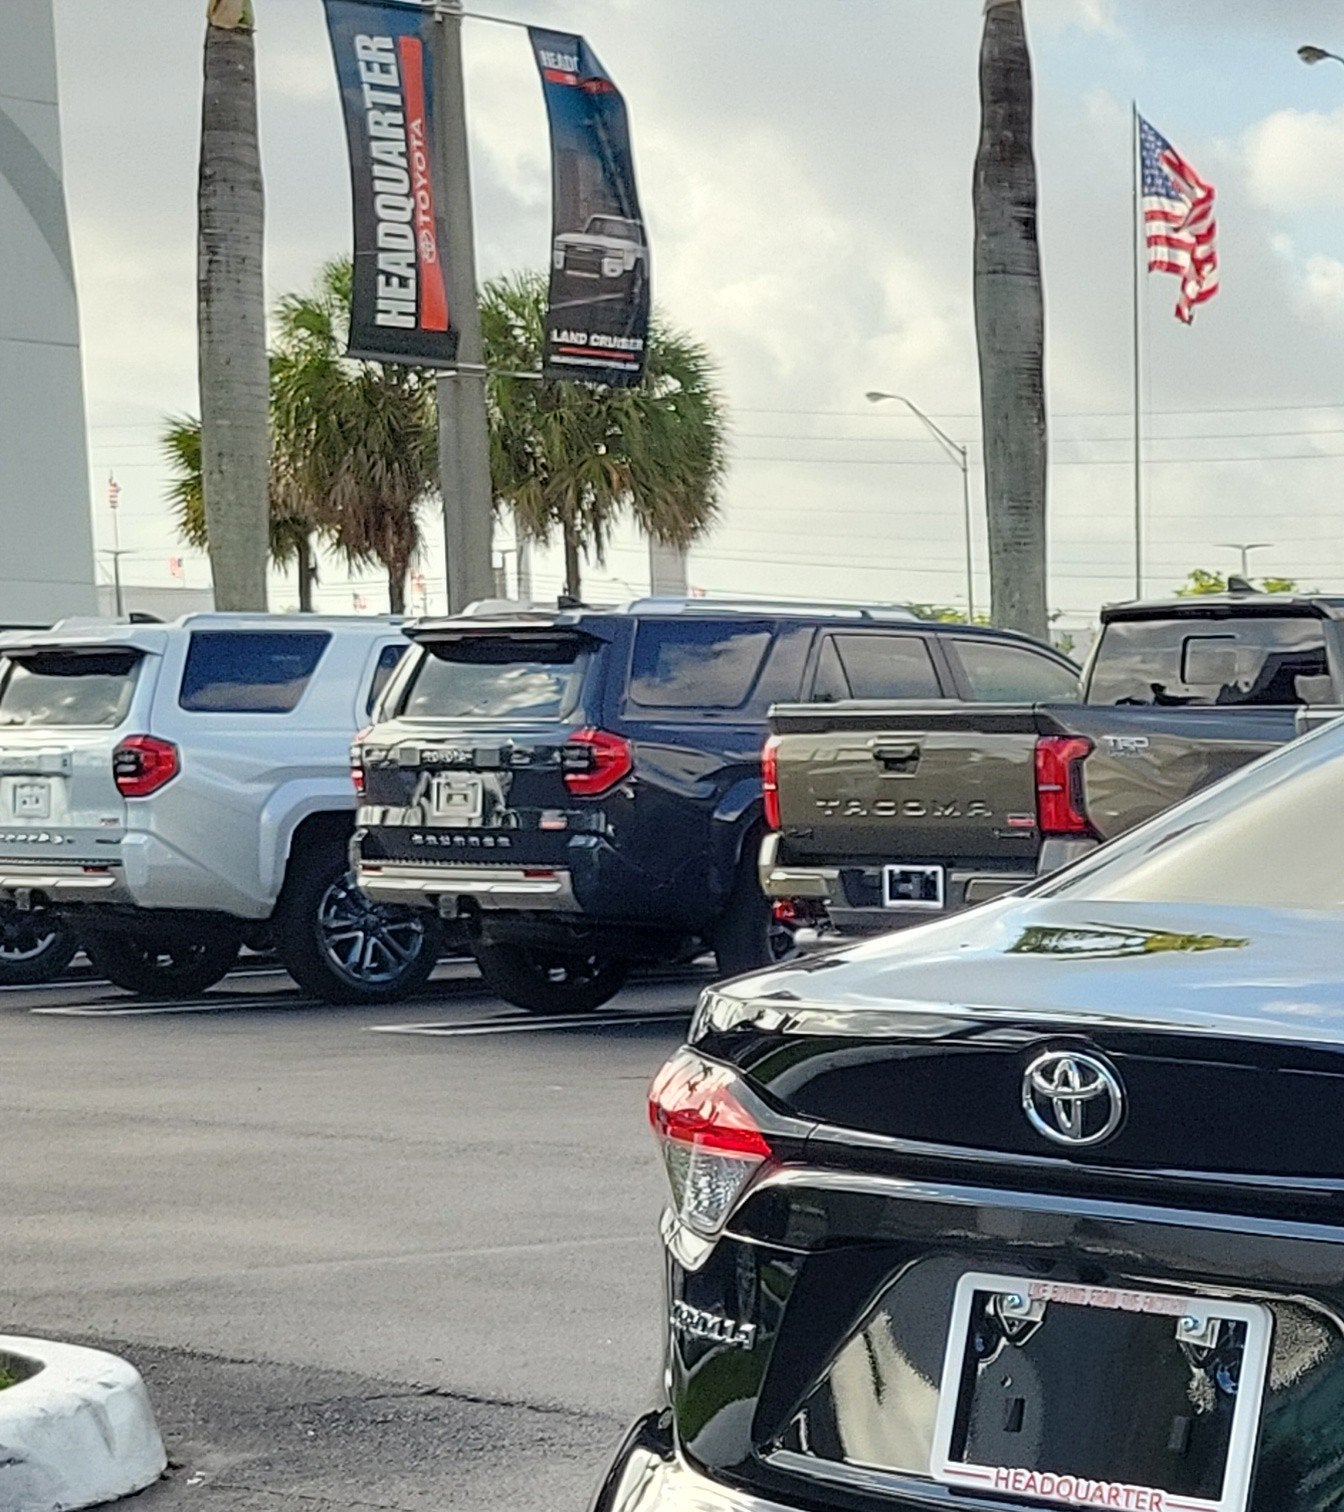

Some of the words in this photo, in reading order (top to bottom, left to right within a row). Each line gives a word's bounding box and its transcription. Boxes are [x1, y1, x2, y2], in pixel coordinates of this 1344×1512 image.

[355, 34, 416, 329] HEADQUARTER
[409, 118, 435, 224] TOYOTA
[552, 328, 588, 345] LAND
[815, 799, 993, 817] TACOMA
[995, 1468, 1163, 1512] HEADQUARTER
